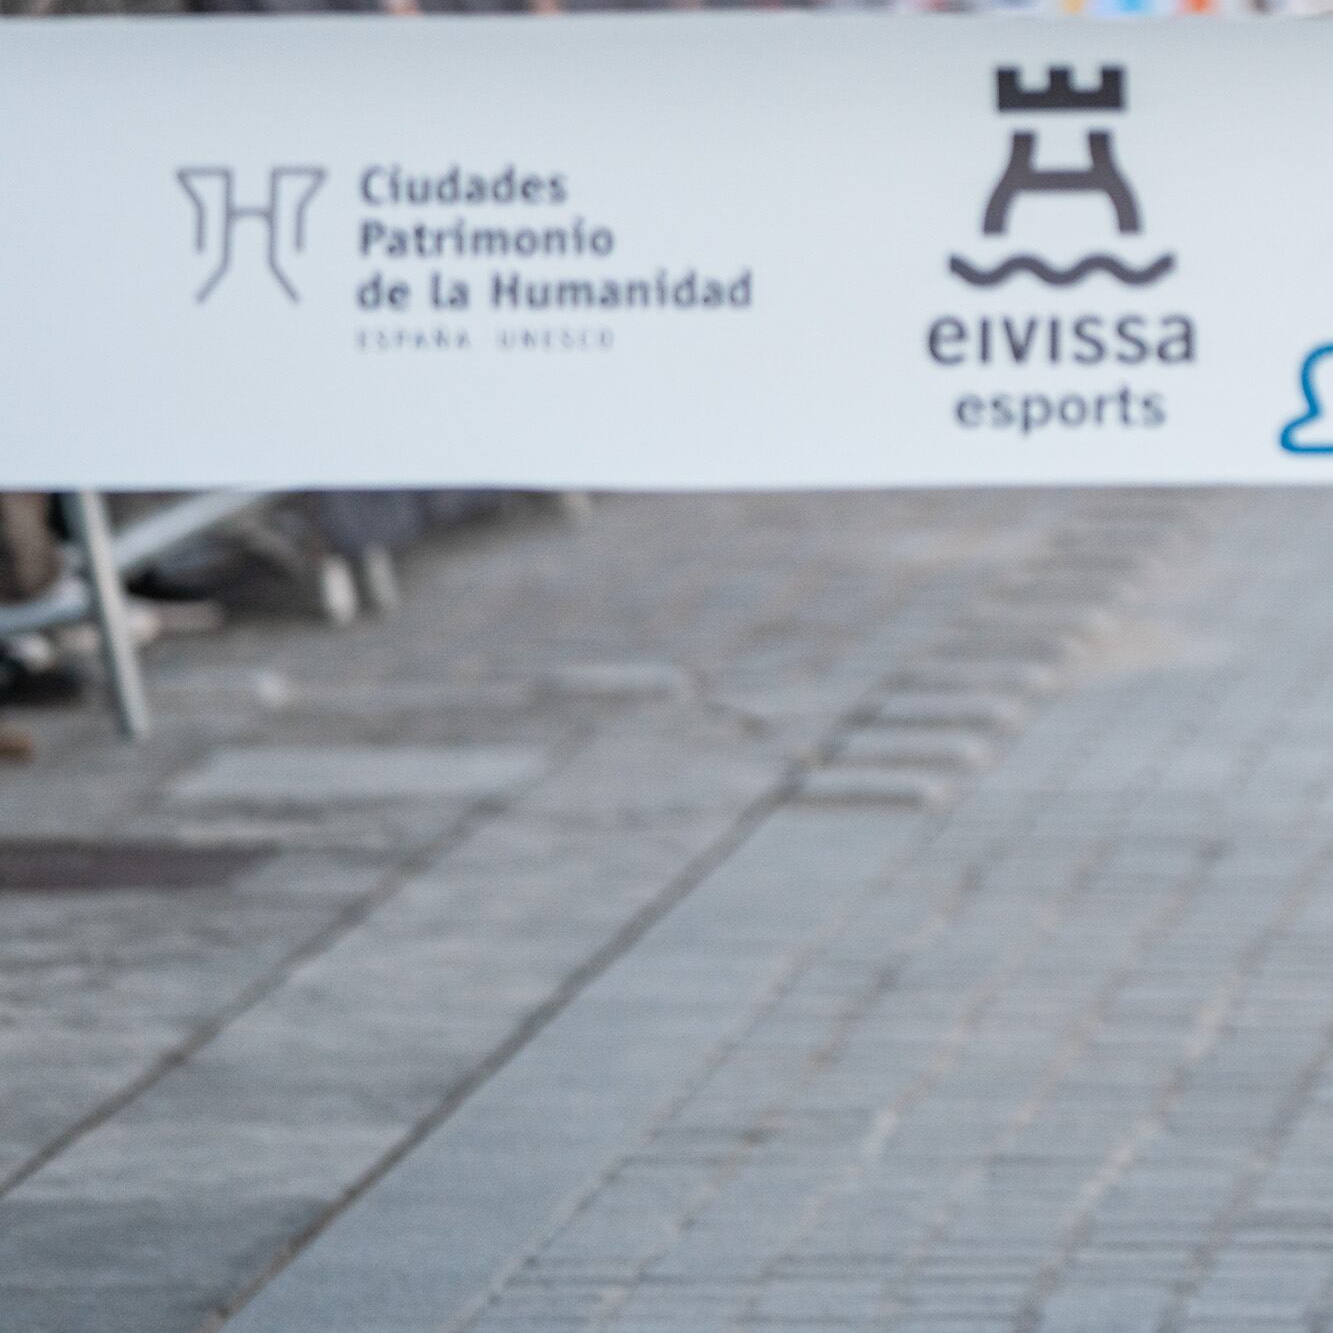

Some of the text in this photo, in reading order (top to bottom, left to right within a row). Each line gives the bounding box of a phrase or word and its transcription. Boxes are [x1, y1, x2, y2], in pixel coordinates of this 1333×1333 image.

[357, 164, 568, 207] Ciudades
[357, 217, 616, 259] Patrimonio
[356, 269, 753, 311] de la Humanidad
[355, 325, 616, 353] ESPAÑA UNESCO
[925, 313, 1197, 367] eivissa
[953, 384, 1168, 436] esports
